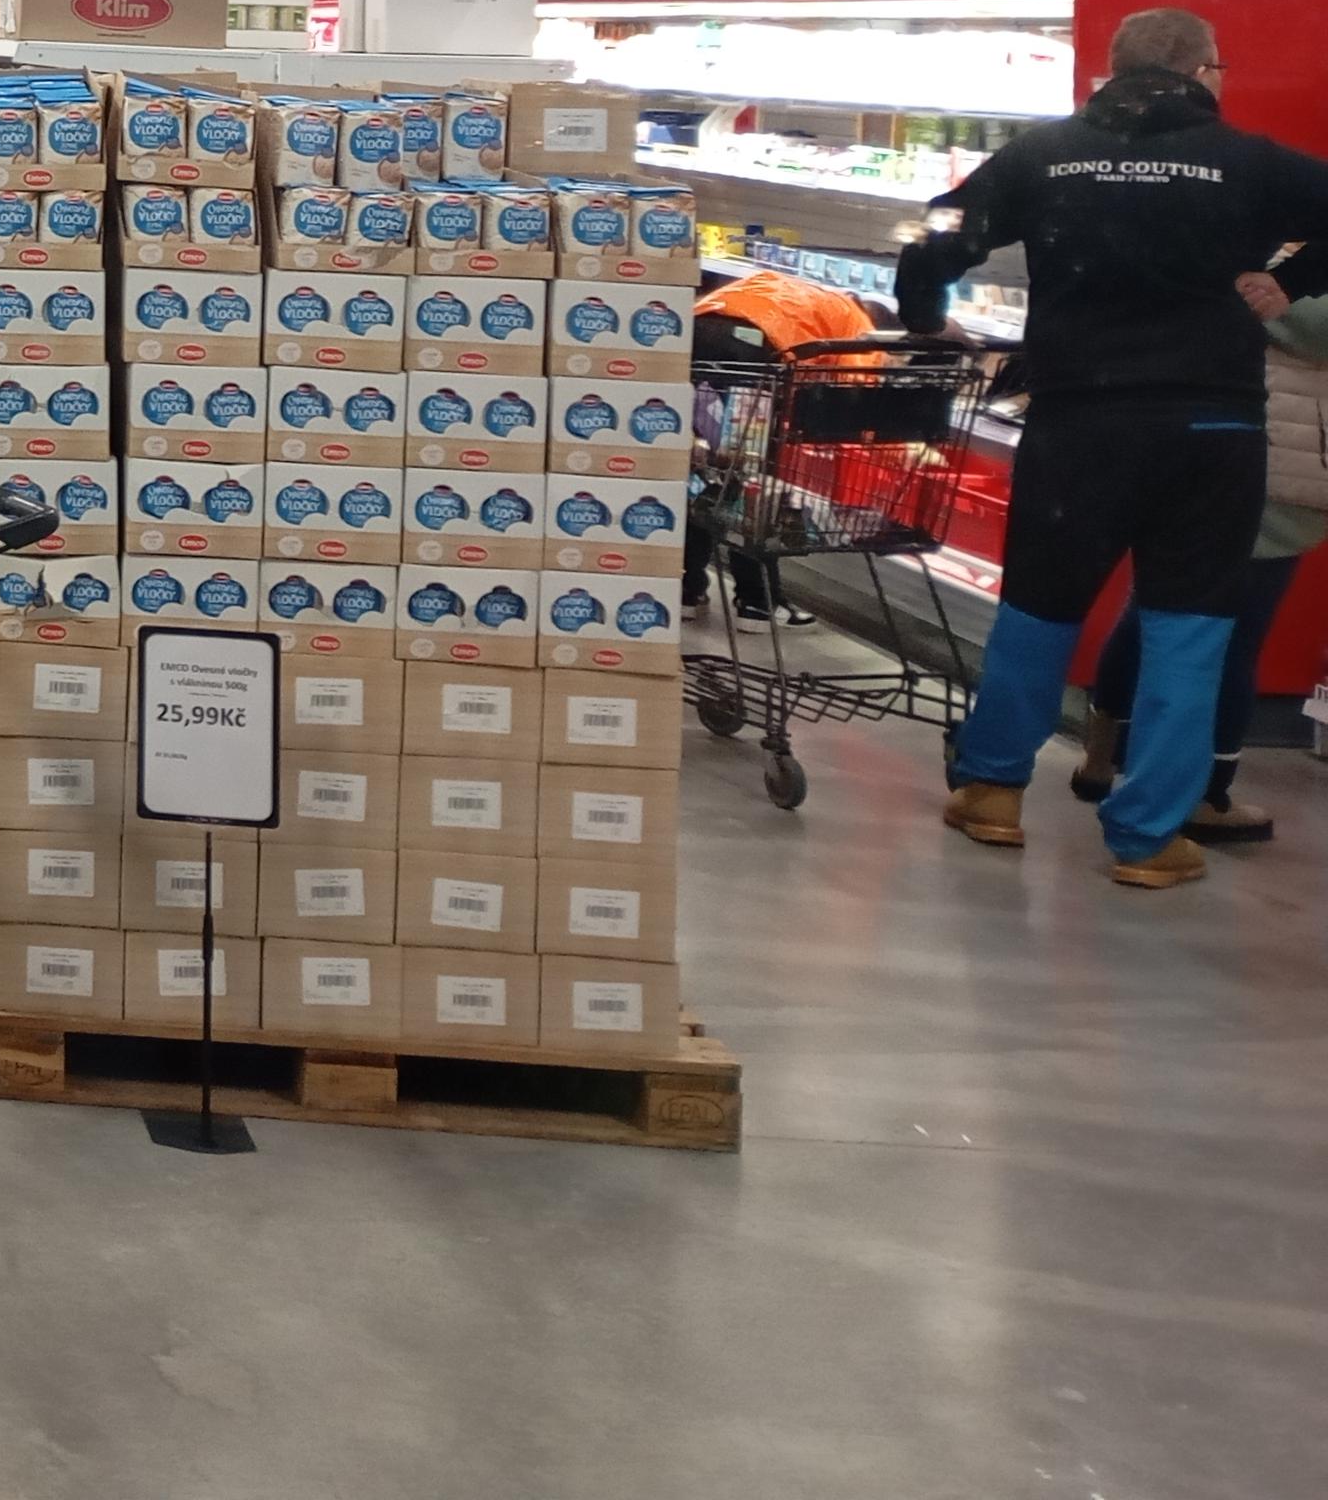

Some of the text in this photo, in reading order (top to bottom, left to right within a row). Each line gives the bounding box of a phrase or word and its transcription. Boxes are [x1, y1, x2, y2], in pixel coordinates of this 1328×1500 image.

[1047, 160, 1224, 183] ICONO COUTURE
[160, 662, 189, 672] EMCO
[225, 680, 248, 692] 500g
[156, 703, 247, 728] 25,99Kč
